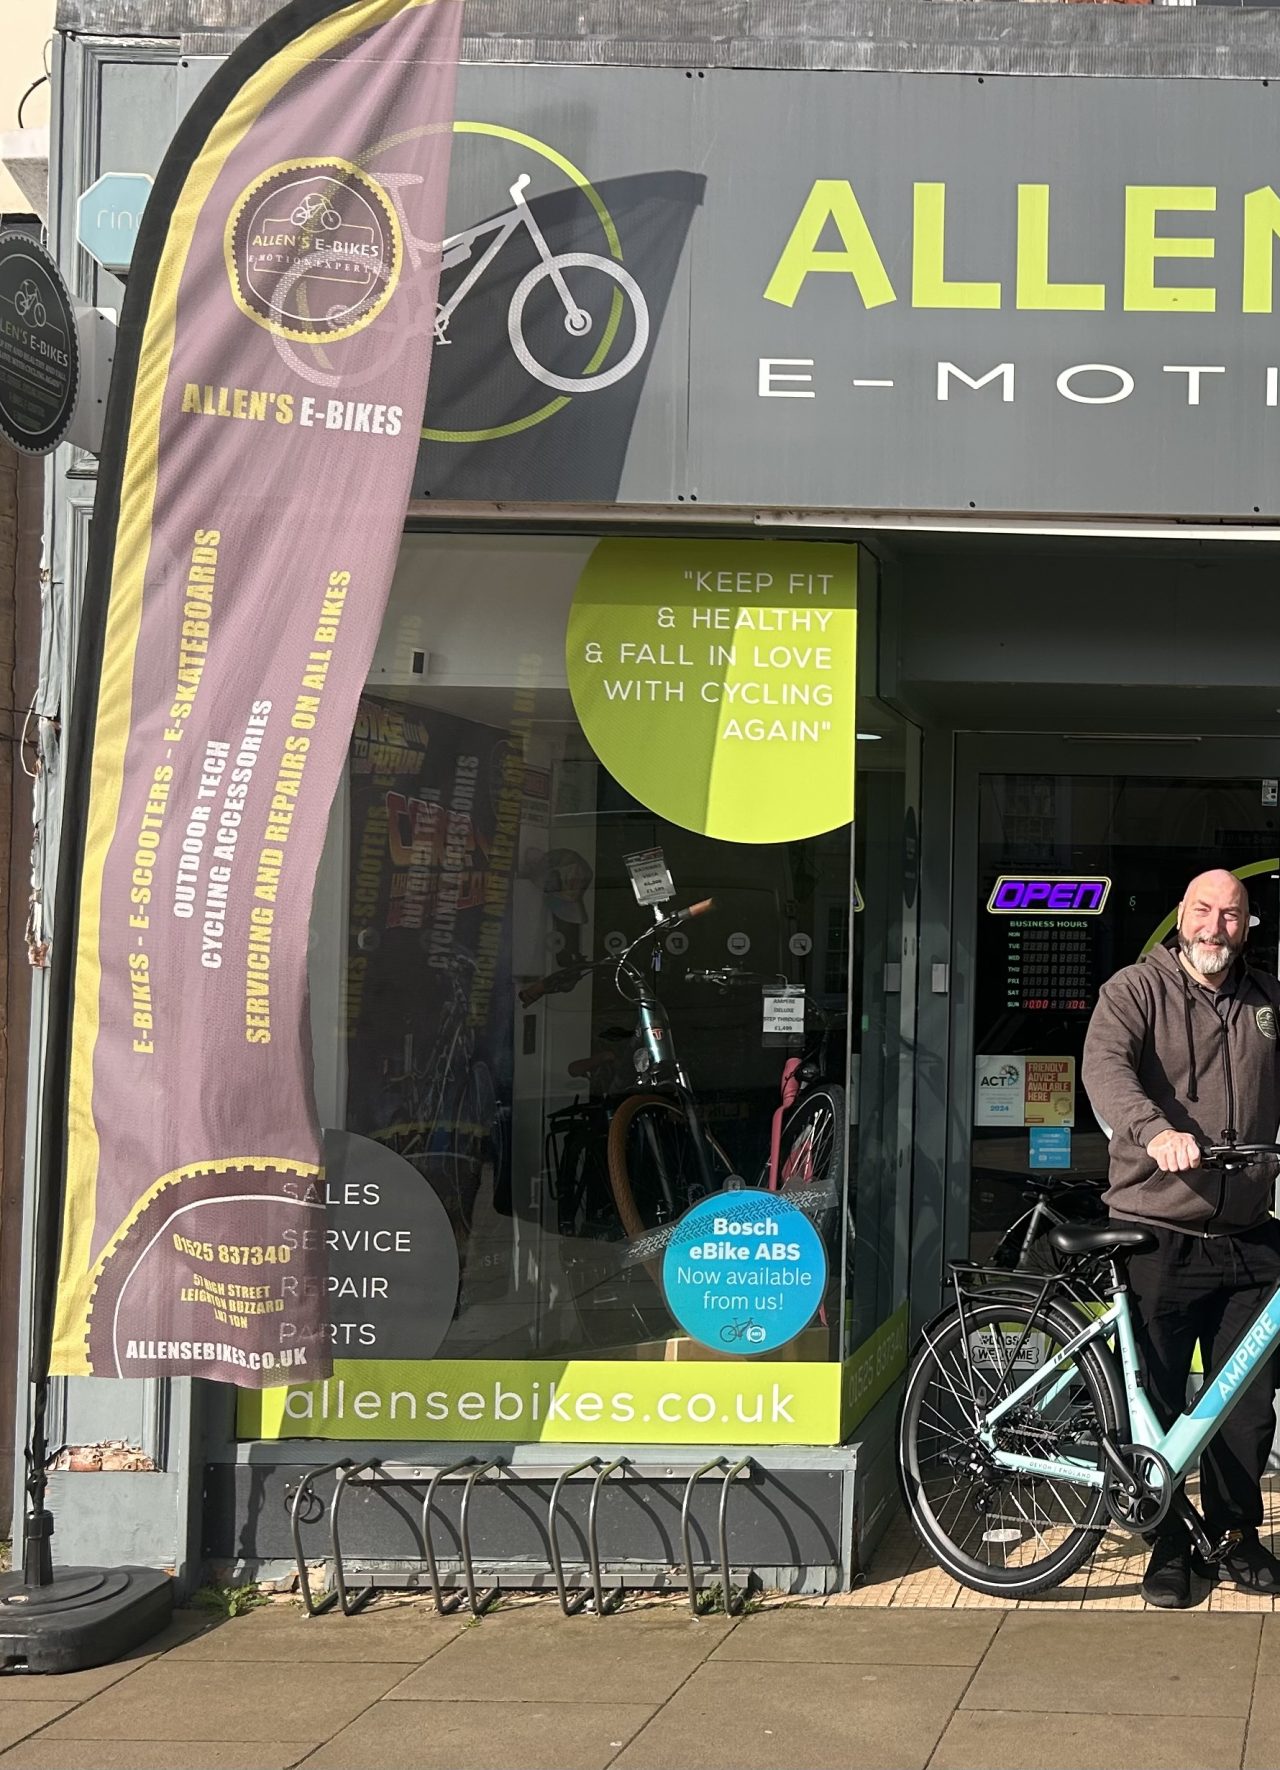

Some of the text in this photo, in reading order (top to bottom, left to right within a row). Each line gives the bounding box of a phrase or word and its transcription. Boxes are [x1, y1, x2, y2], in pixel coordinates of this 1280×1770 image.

[252, 235, 379, 257] ALLEN'S E-BIKES
[0, 317, 28, 345] LEN'S
[30, 334, 69, 368] E-BIKES
[182, 383, 403, 437] ALLEN'S E-BIKES
[684, 570, 834, 595] "KEEP FIT
[657, 607, 834, 632] & HEALTHY
[585, 642, 833, 670] & FALL IN LOVE
[603, 680, 834, 706] WITH CYCLING
[722, 719, 832, 742] AGAIN"
[129, 529, 221, 1054] E-BIKES E-SCOOTERS E-SKATEBOARDS
[246, 569, 351, 1045] SERVICING AND REPAIRS ON ALL BIKES
[173, 740, 230, 918] OUTDOOR TECH
[201, 700, 273, 969] CYCLING ACCESSORIES
[995, 882, 1103, 909] OPEN
[1028, 1063, 1064, 1073] FRIENDLY
[1028, 1073, 1057, 1081] ADVICE
[1028, 1082, 1070, 1092] AVAILABLE
[1028, 1092, 1049, 1101] HERE
[281, 1182, 380, 1206] SALES
[713, 1218, 779, 1236] Bosch
[173, 1233, 291, 1267] 01525 837340
[281, 1228, 412, 1253] SERVICE
[689, 1242, 801, 1261] eBike ABS
[281, 1275, 389, 1299] REPAIR
[677, 1266, 812, 1286] Now available
[227, 1283, 271, 1301] STREET
[703, 1291, 784, 1311] from us!
[228, 1298, 285, 1314] BUZZARD
[279, 1322, 377, 1345] PARTS
[989, 1335, 1019, 1346] DGS
[126, 1340, 308, 1371] ALLENSEBIKES.CO.UK
[1218, 1312, 1278, 1402] AMPERE
[285, 1381, 796, 1425] allensebikes.co.uk
